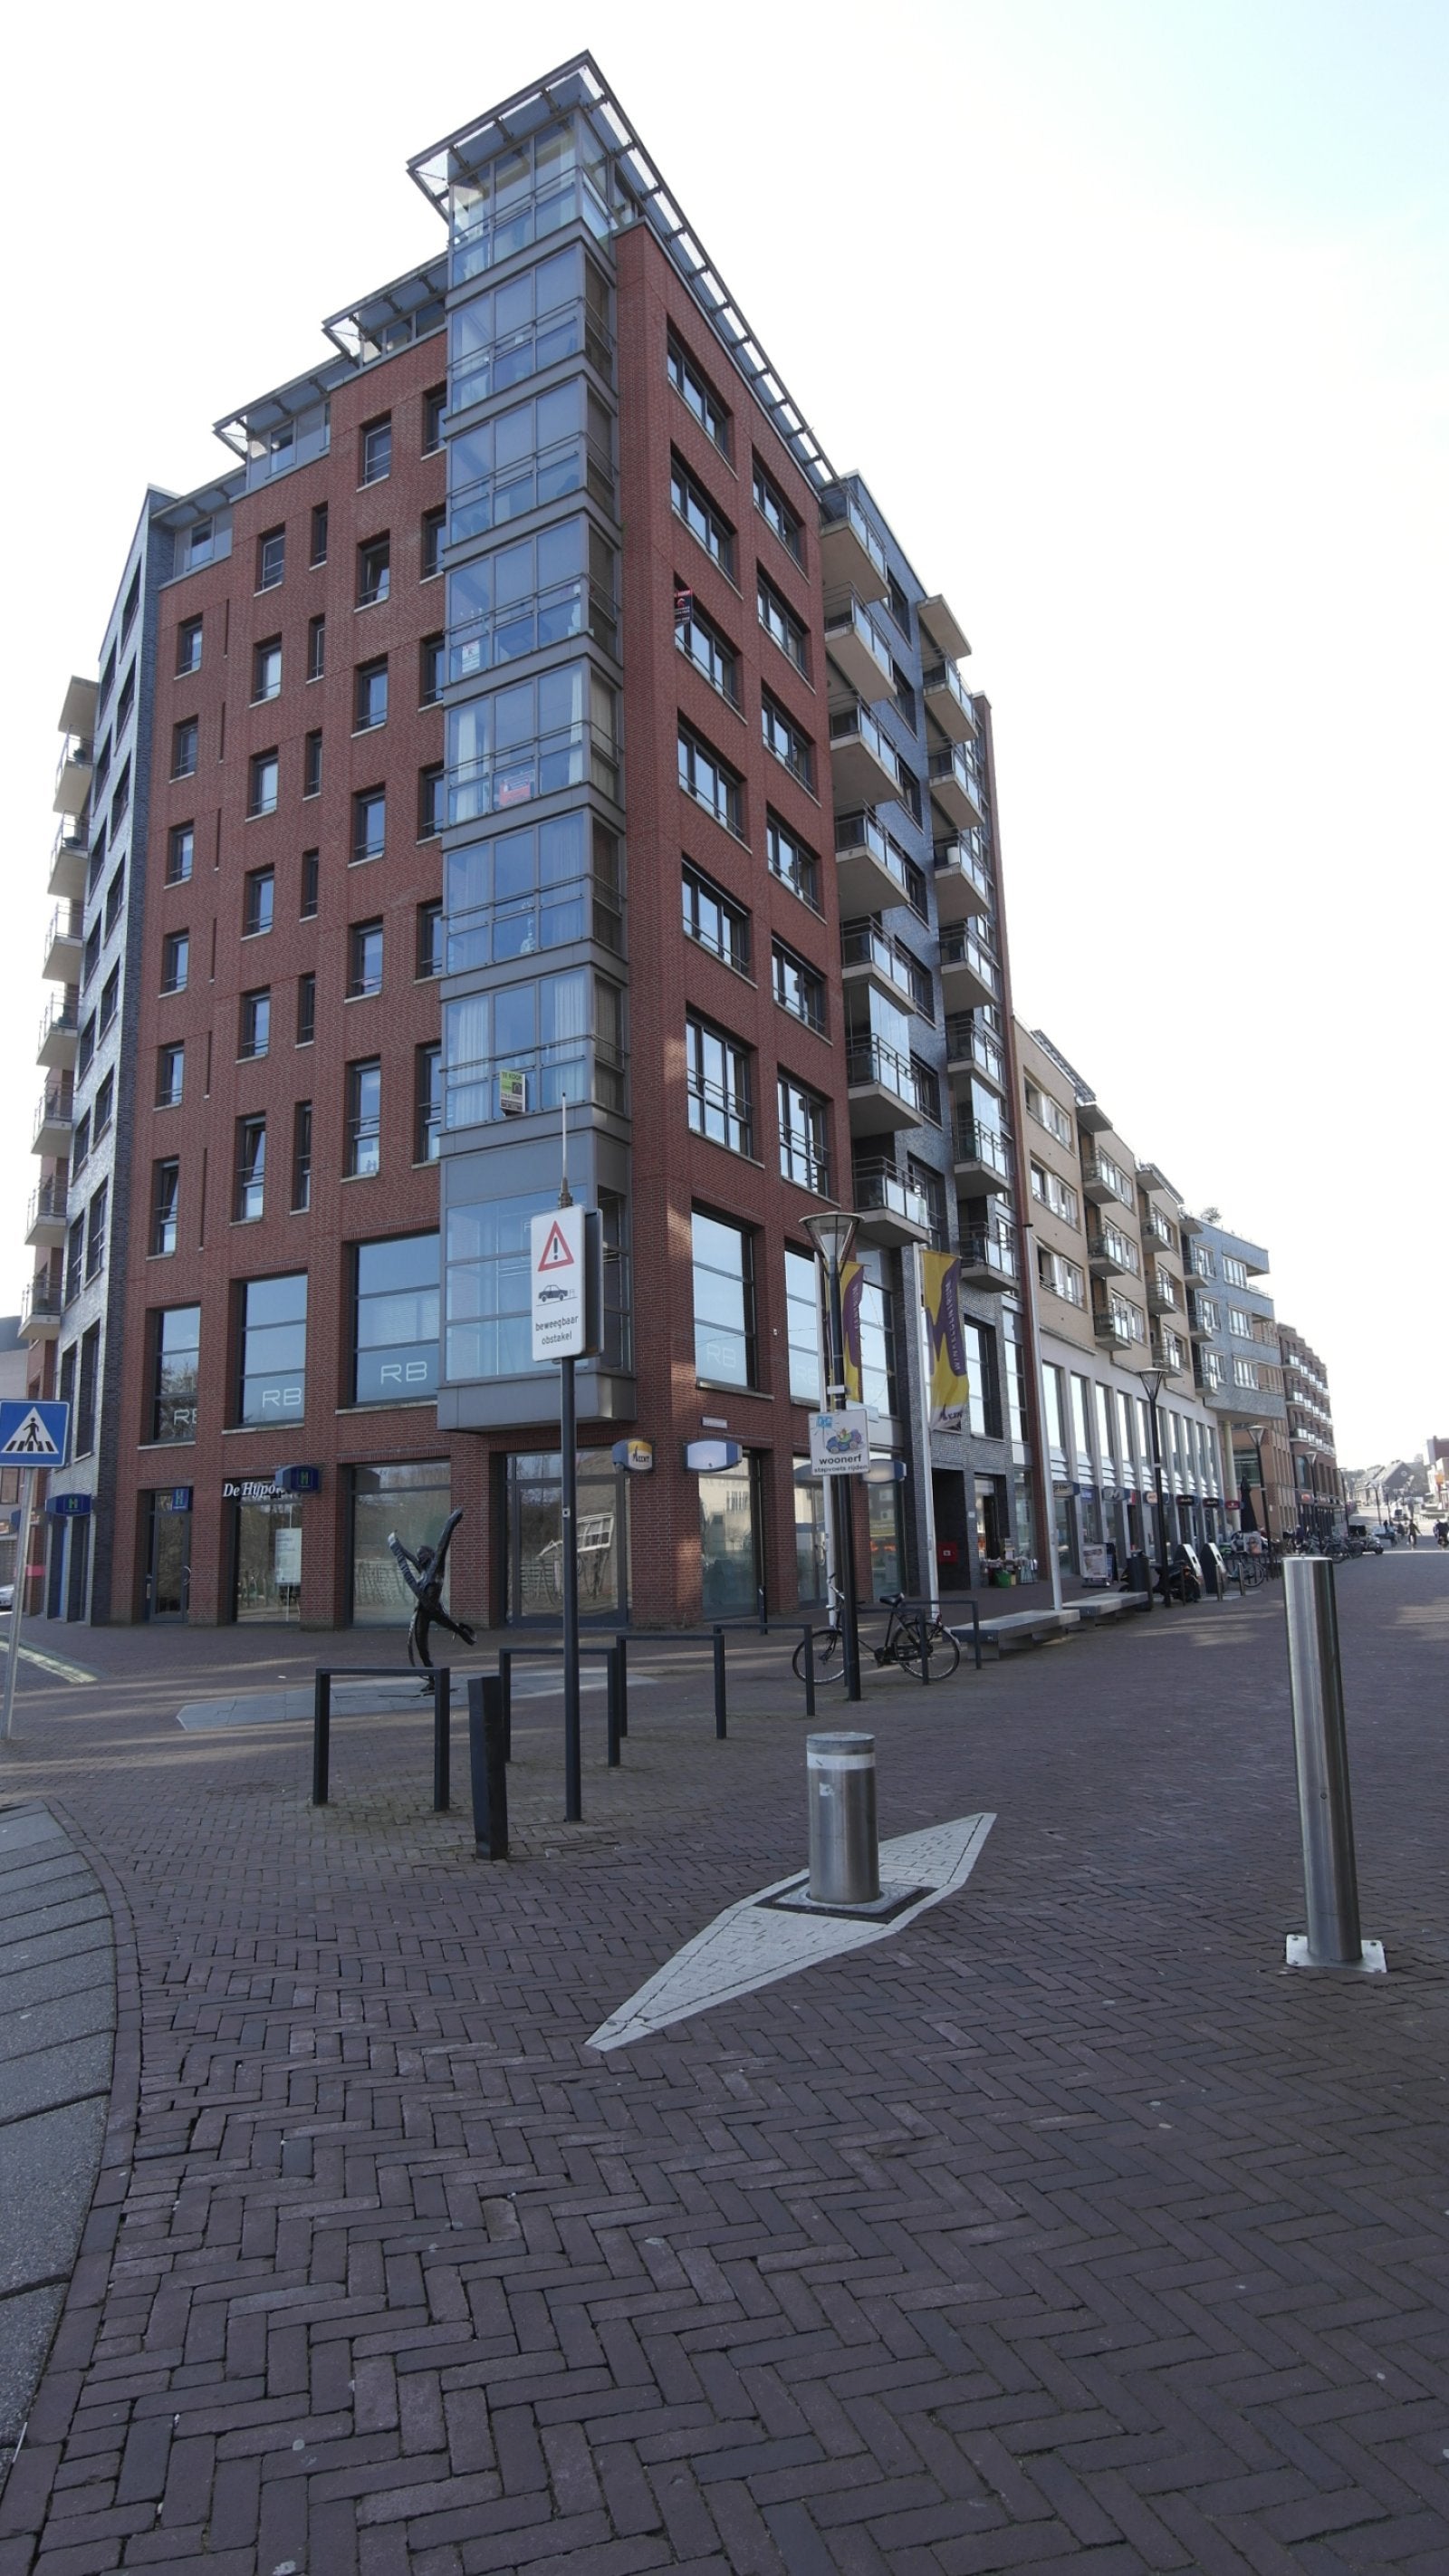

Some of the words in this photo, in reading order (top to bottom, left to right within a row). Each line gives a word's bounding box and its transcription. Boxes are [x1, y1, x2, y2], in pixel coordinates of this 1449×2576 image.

[535, 1316, 579, 1331] beweegbaar
[542, 1331, 572, 1345] obstakel
[706, 1342, 736, 1369] RB
[380, 1360, 427, 1385] RB
[262, 1387, 302, 1408] RB
[819, 1453, 862, 1465] woonerf
[814, 1465, 846, 1474] stapvoets
[849, 1464, 868, 1472] rijden
[223, 1483, 240, 1497] De
